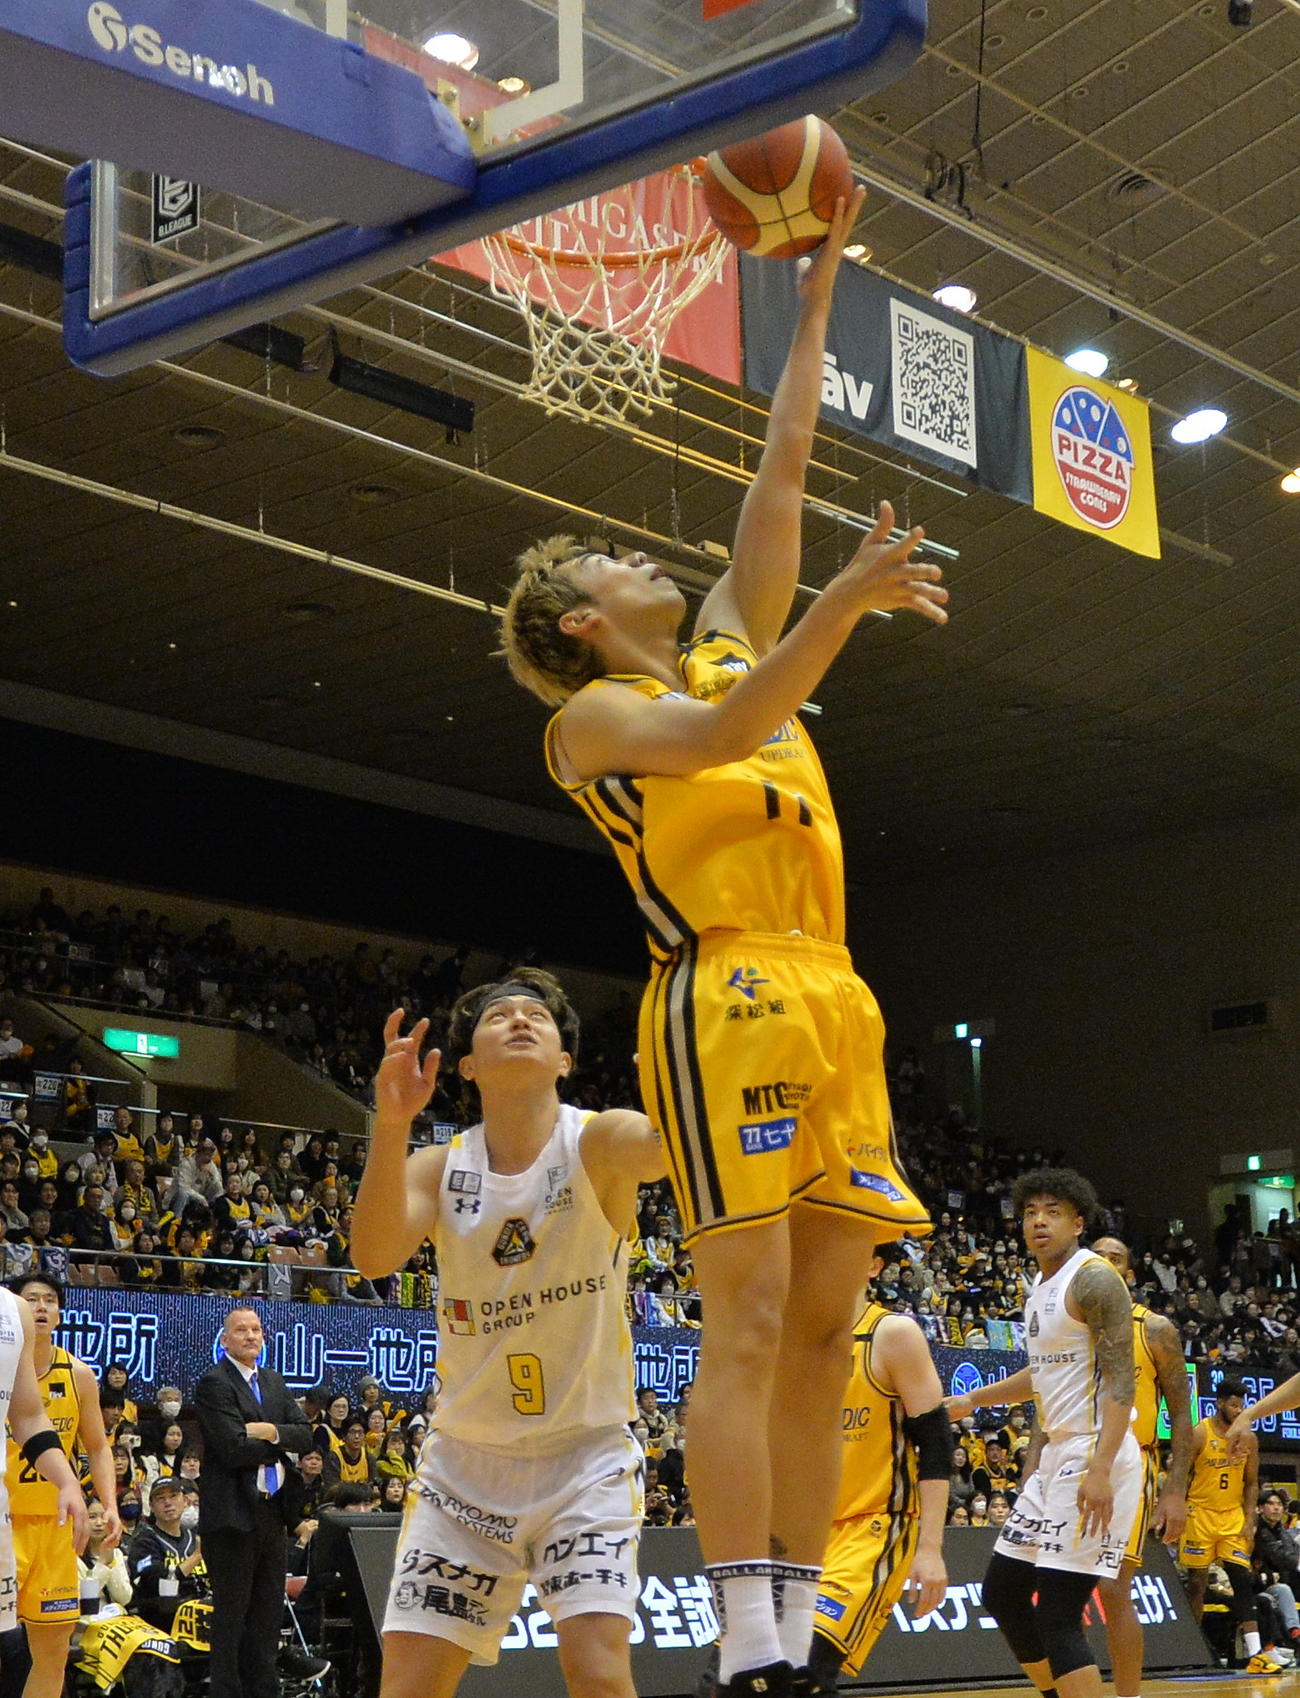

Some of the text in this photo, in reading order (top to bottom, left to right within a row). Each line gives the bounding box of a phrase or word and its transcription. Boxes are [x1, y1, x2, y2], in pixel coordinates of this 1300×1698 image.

[129, 24, 275, 106] Senoh
[1058, 433, 1127, 484] PIZZA
[743, 1126, 761, 1144] 77
[481, 1275, 607, 1317] OPEN HOUSE
[482, 1312, 536, 1335] GROUP
[1040, 1353, 1078, 1365] HOUSE
[507, 1353, 546, 1416] 9
[50, 1416, 75, 1432] EDIC
[1219, 1473, 1229, 1490] 6
[456, 1514, 513, 1544] SYSTEMS
